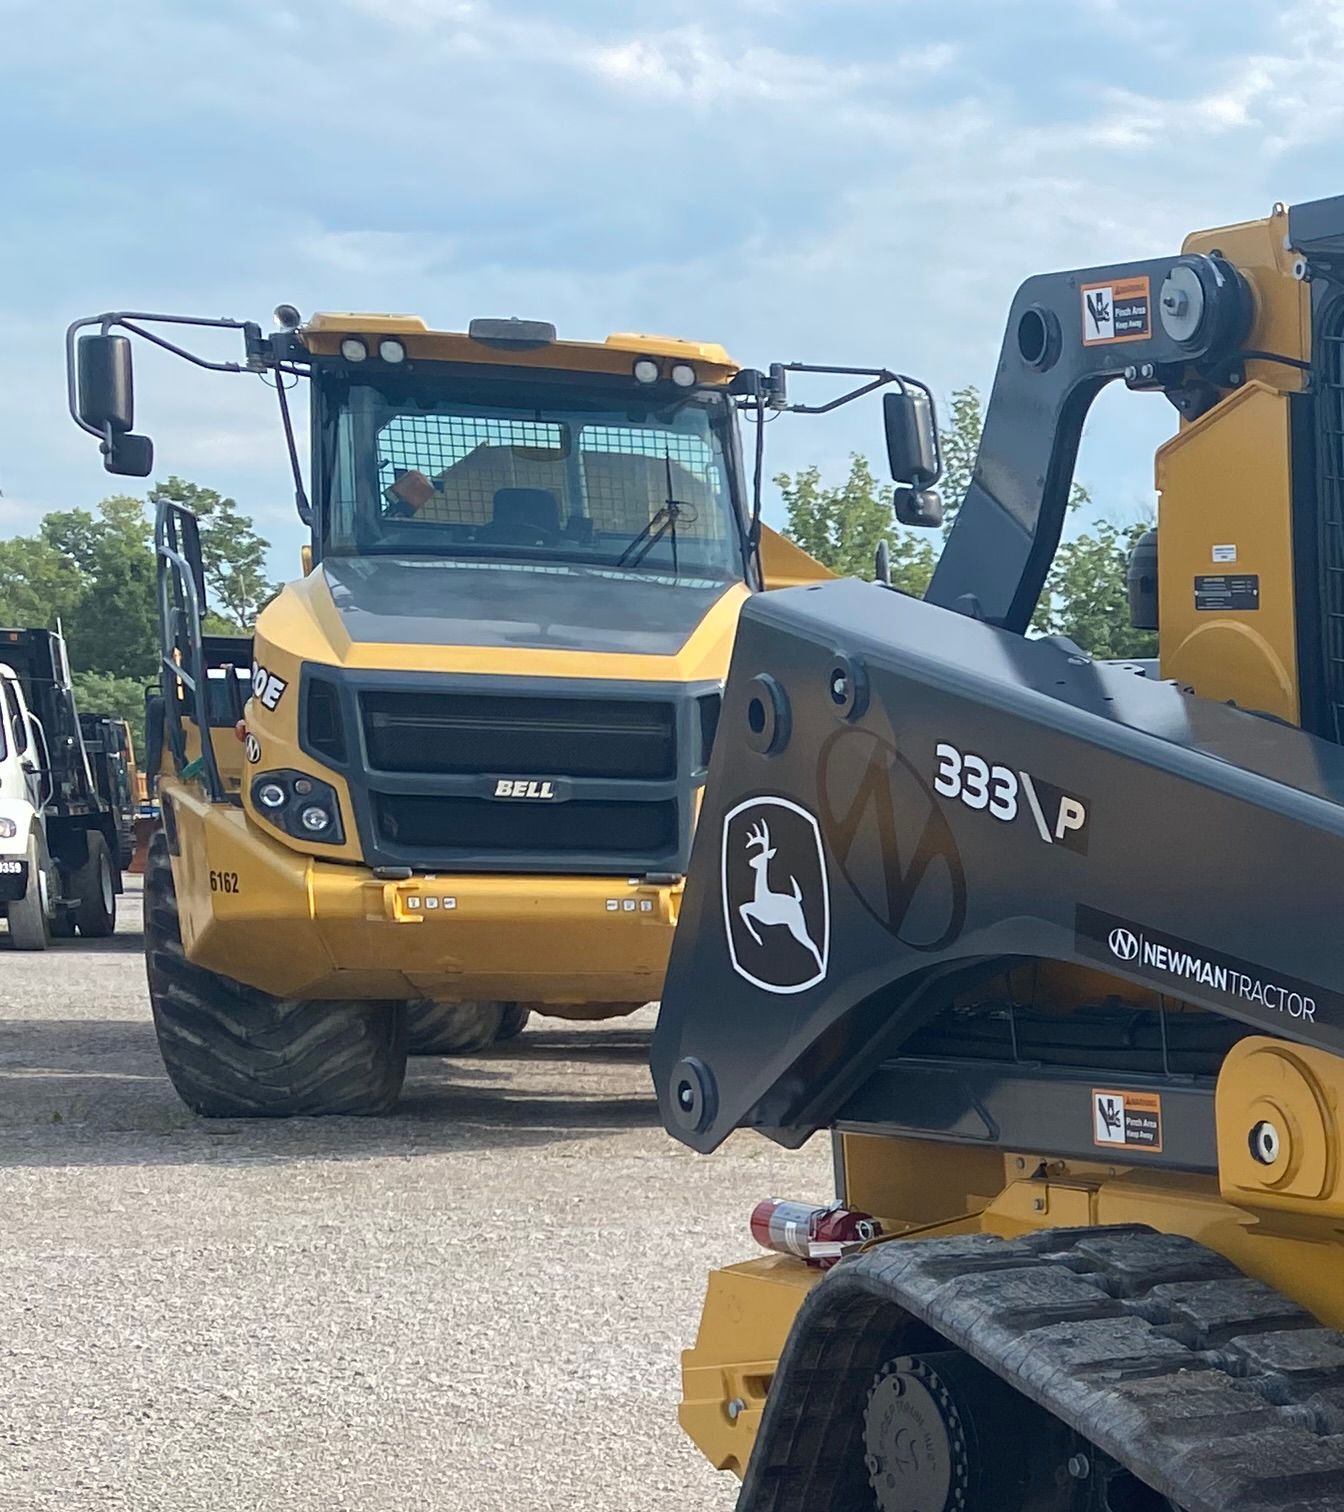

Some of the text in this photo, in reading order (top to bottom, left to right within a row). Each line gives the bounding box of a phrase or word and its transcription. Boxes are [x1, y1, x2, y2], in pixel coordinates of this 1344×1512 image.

[253, 661, 285, 709] 0E
[494, 780, 553, 798] BELL
[0, 861, 22, 874] 359
[210, 870, 239, 893] 6162
[1143, 941, 1316, 1023] NEWMANTRACTOR
